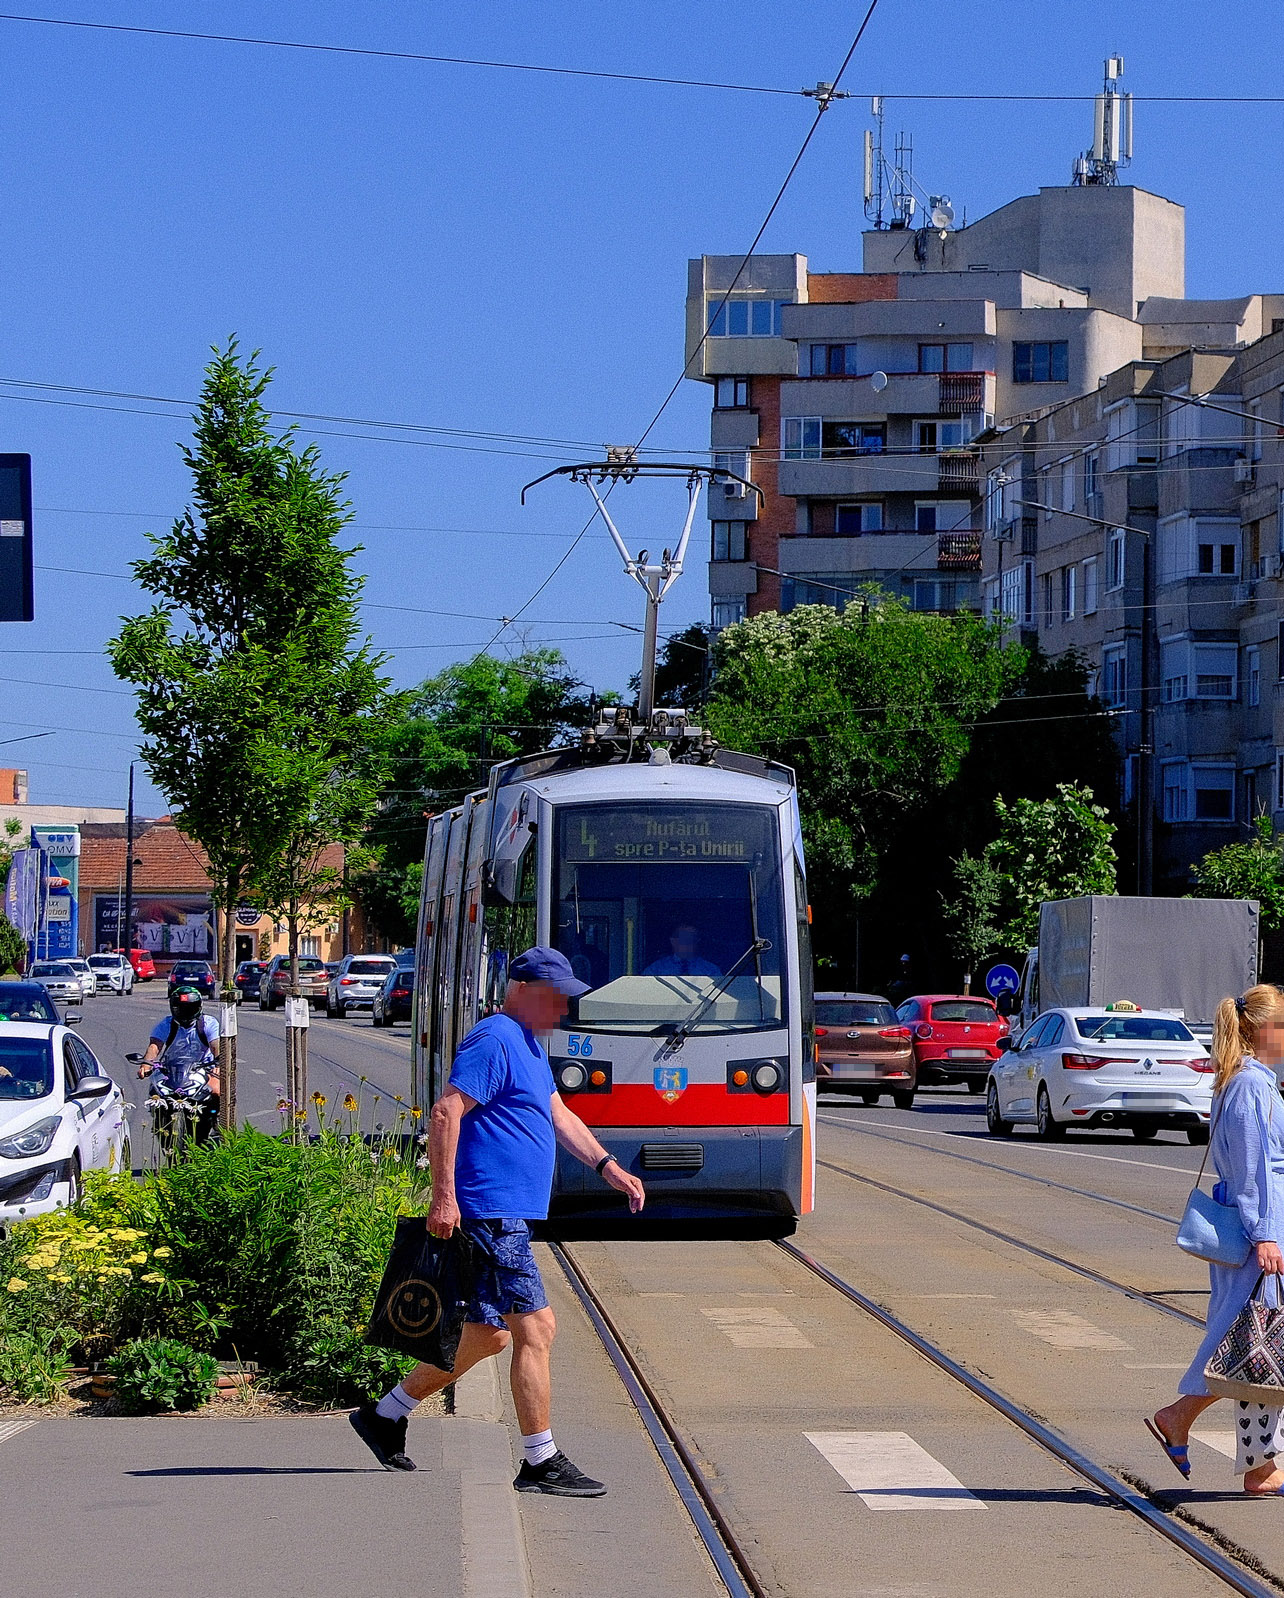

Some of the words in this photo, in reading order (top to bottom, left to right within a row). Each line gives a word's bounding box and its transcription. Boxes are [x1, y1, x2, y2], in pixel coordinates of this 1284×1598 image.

[581, 820, 597, 857] 4
[614, 841, 654, 857] spre
[701, 840, 744, 856] Unirii
[47, 845, 74, 854] OMV
[567, 1034, 593, 1057] 56
